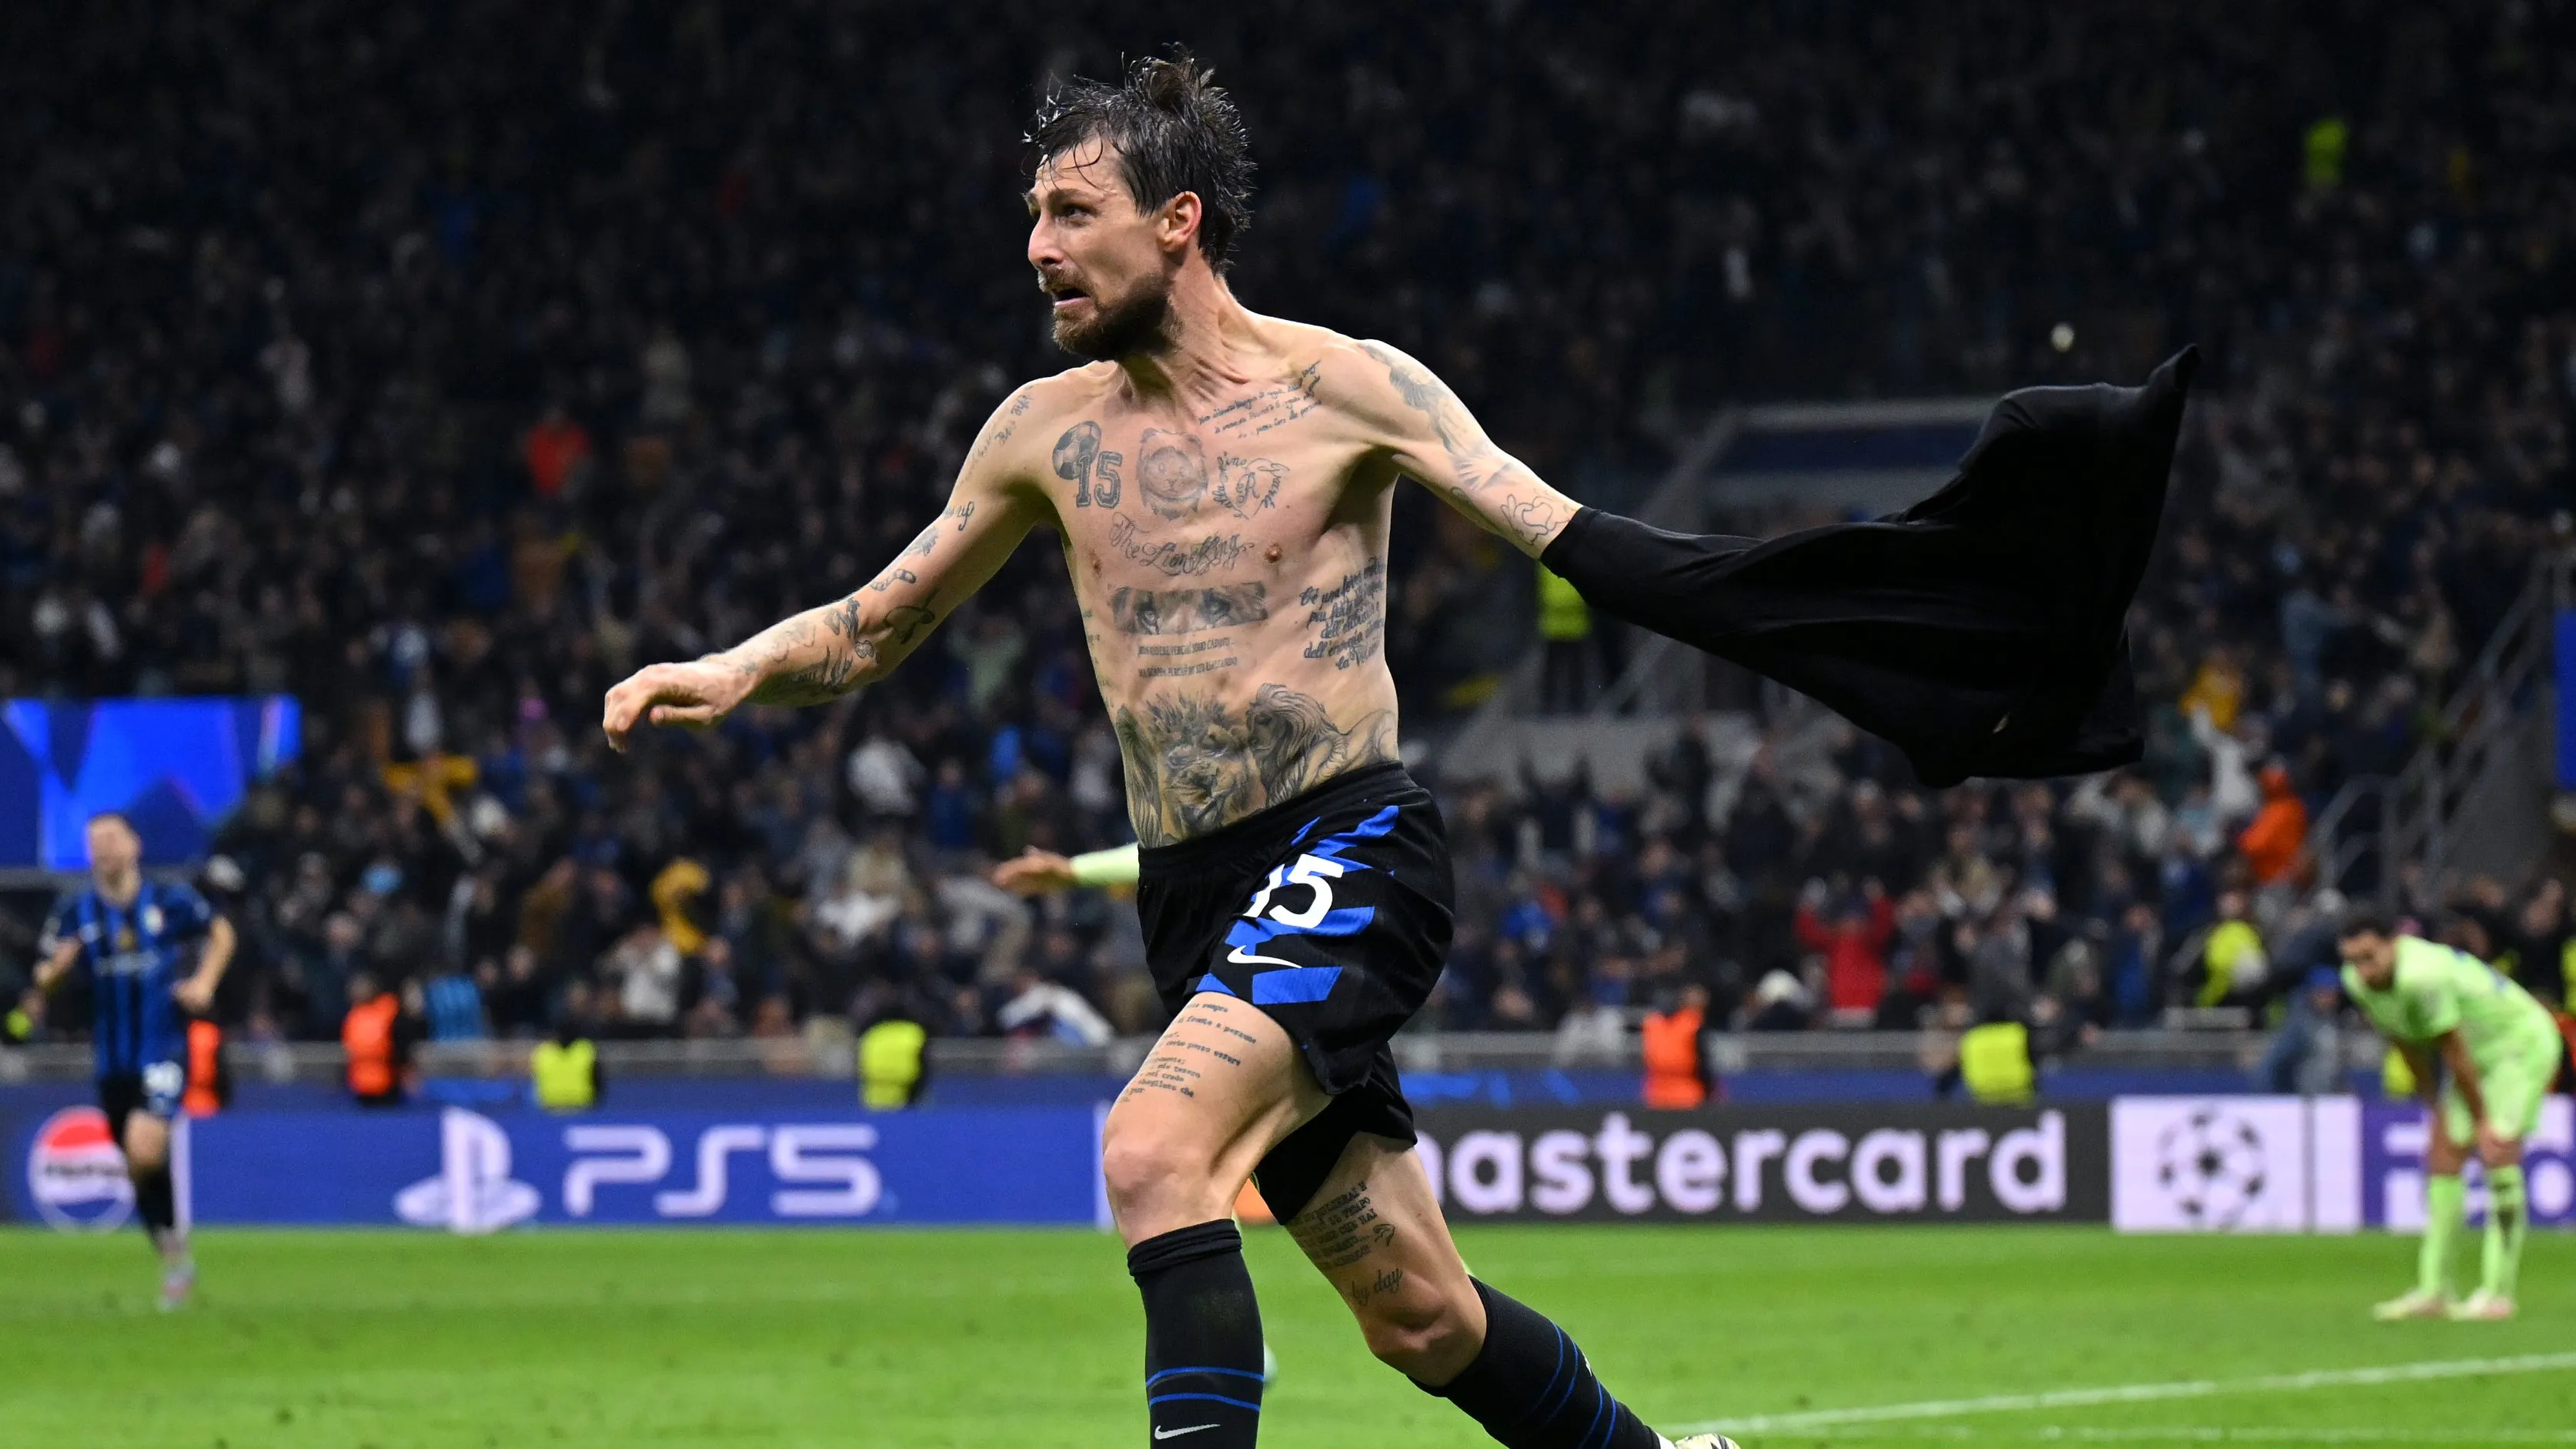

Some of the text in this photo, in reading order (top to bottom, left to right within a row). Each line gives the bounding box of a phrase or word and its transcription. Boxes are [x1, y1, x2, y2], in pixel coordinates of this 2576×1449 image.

[1076, 451, 1123, 509] 15
[1243, 853, 1345, 930] 15
[563, 1124, 882, 1217] PS5
[1358, 1207, 1378, 1225] HAI
